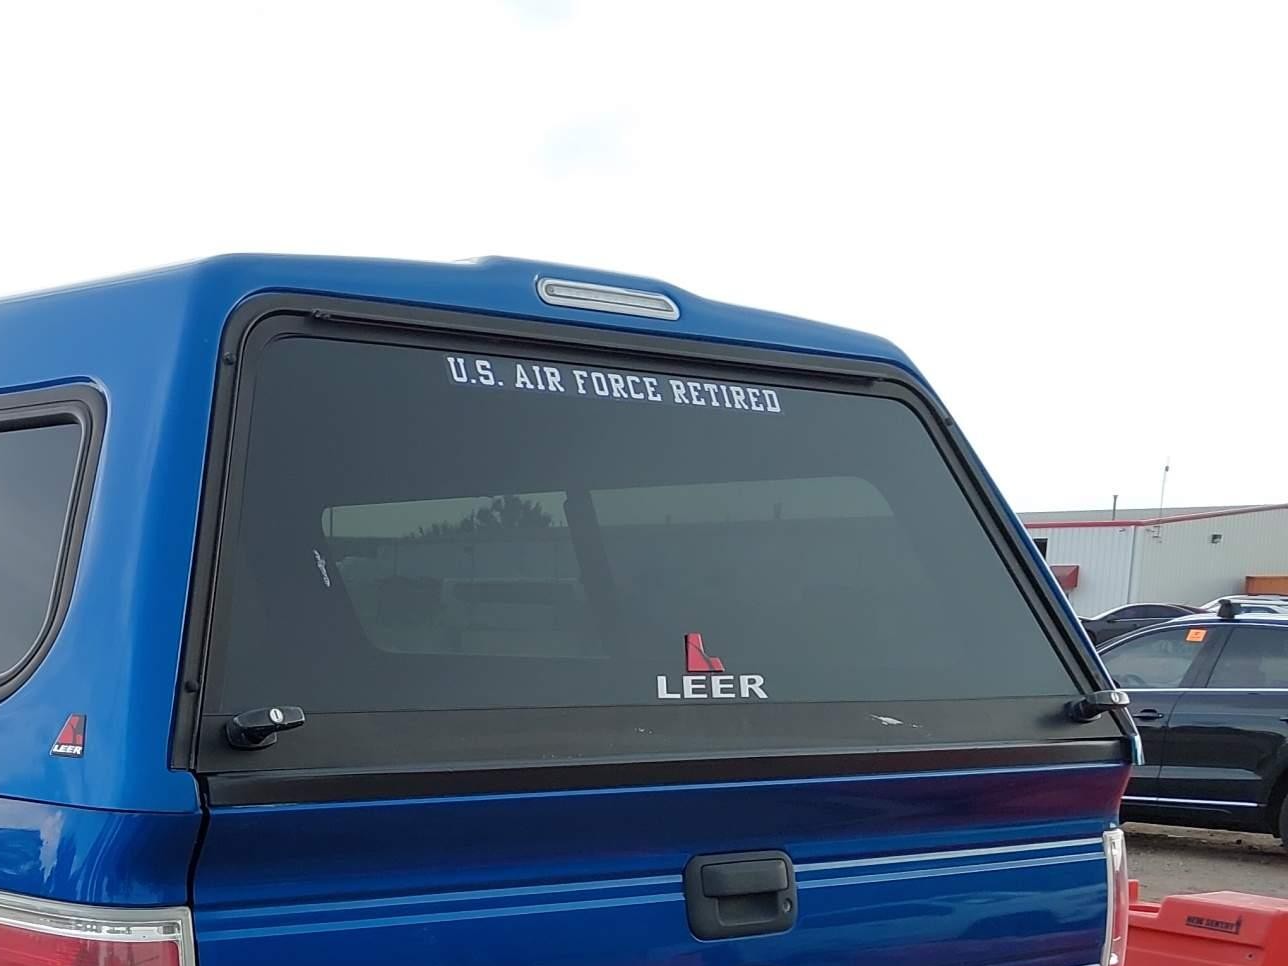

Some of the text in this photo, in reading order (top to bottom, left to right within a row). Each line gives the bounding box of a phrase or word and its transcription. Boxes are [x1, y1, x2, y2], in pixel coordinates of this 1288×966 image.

[446, 356, 782, 413] U.S. AIR FORCE RETIRED
[656, 674, 769, 699] LEER
[52, 744, 83, 755] LEER
